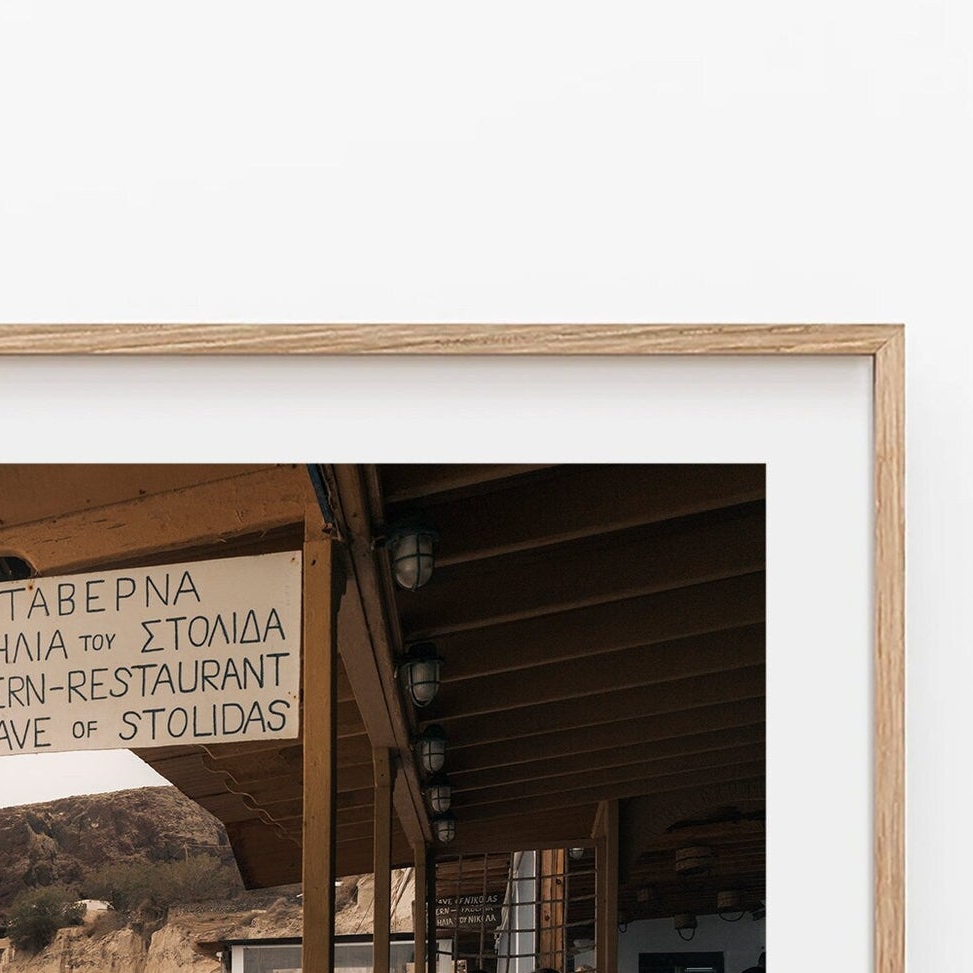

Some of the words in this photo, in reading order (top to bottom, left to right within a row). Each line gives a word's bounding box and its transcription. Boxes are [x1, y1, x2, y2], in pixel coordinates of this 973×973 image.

[79, 633, 116, 651] ΤΟΥ
[141, 608, 286, 653] ΣΤΟΛΙΔΑ
[72, 720, 98, 739] OF
[119, 699, 290, 741] STOLIDAS
[464, 894, 498, 905] NIKOAS
